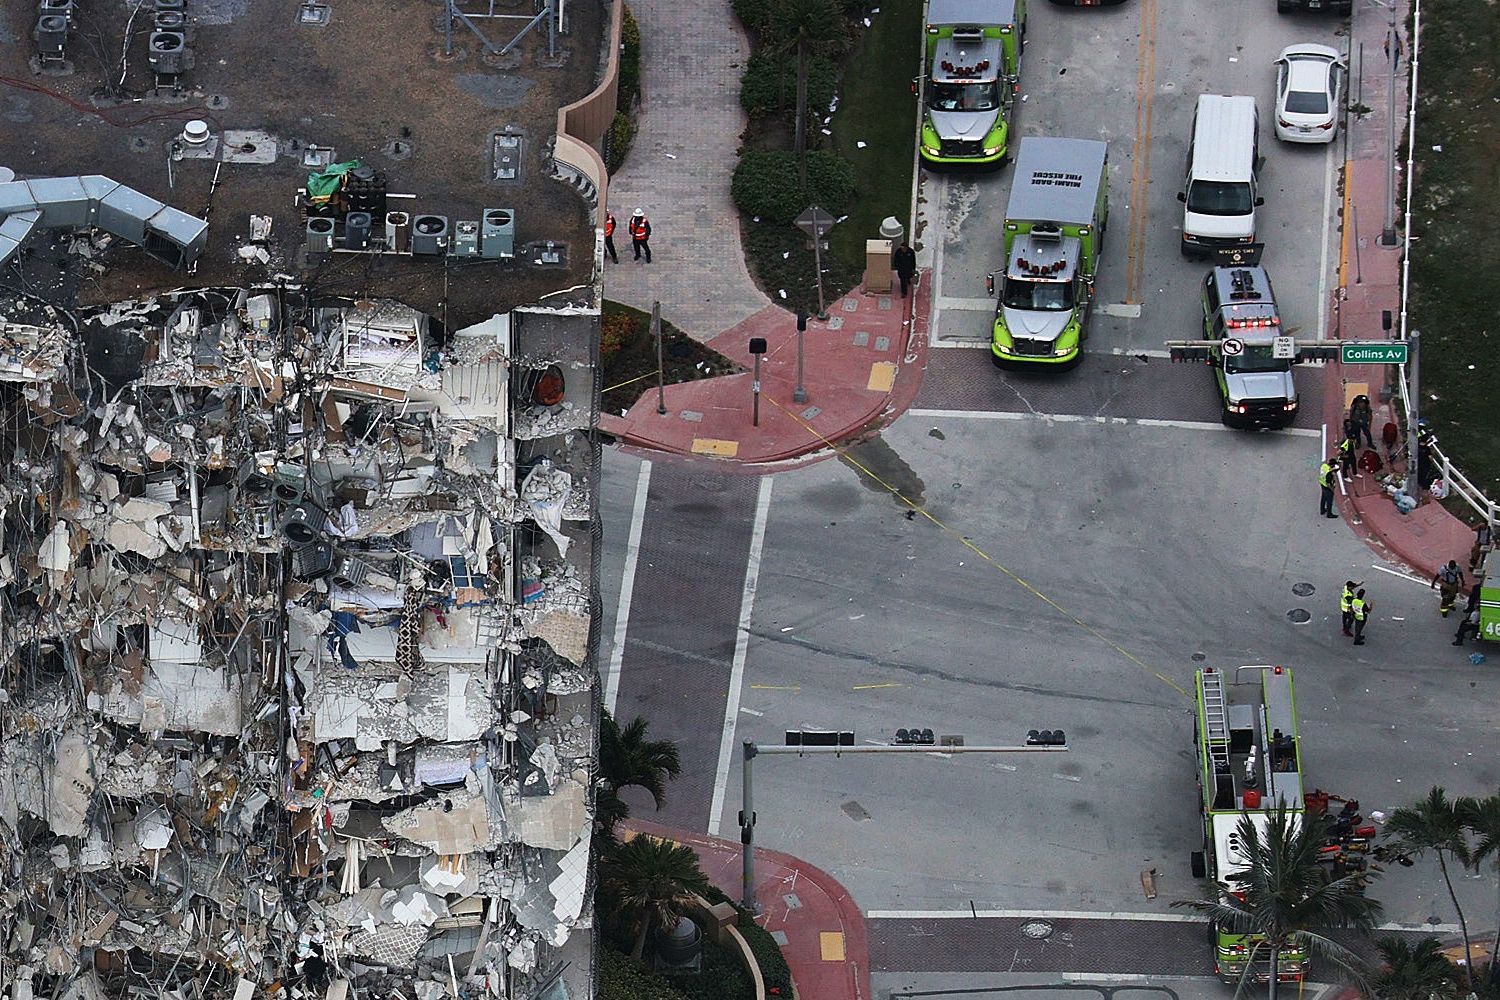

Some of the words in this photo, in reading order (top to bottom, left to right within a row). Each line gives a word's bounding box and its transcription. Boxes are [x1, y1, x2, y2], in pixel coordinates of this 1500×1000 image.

[1031, 179, 1081, 188] MIAMI-DADE
[1347, 349, 1384, 359] Collins
[1385, 350, 1402, 359] Av
